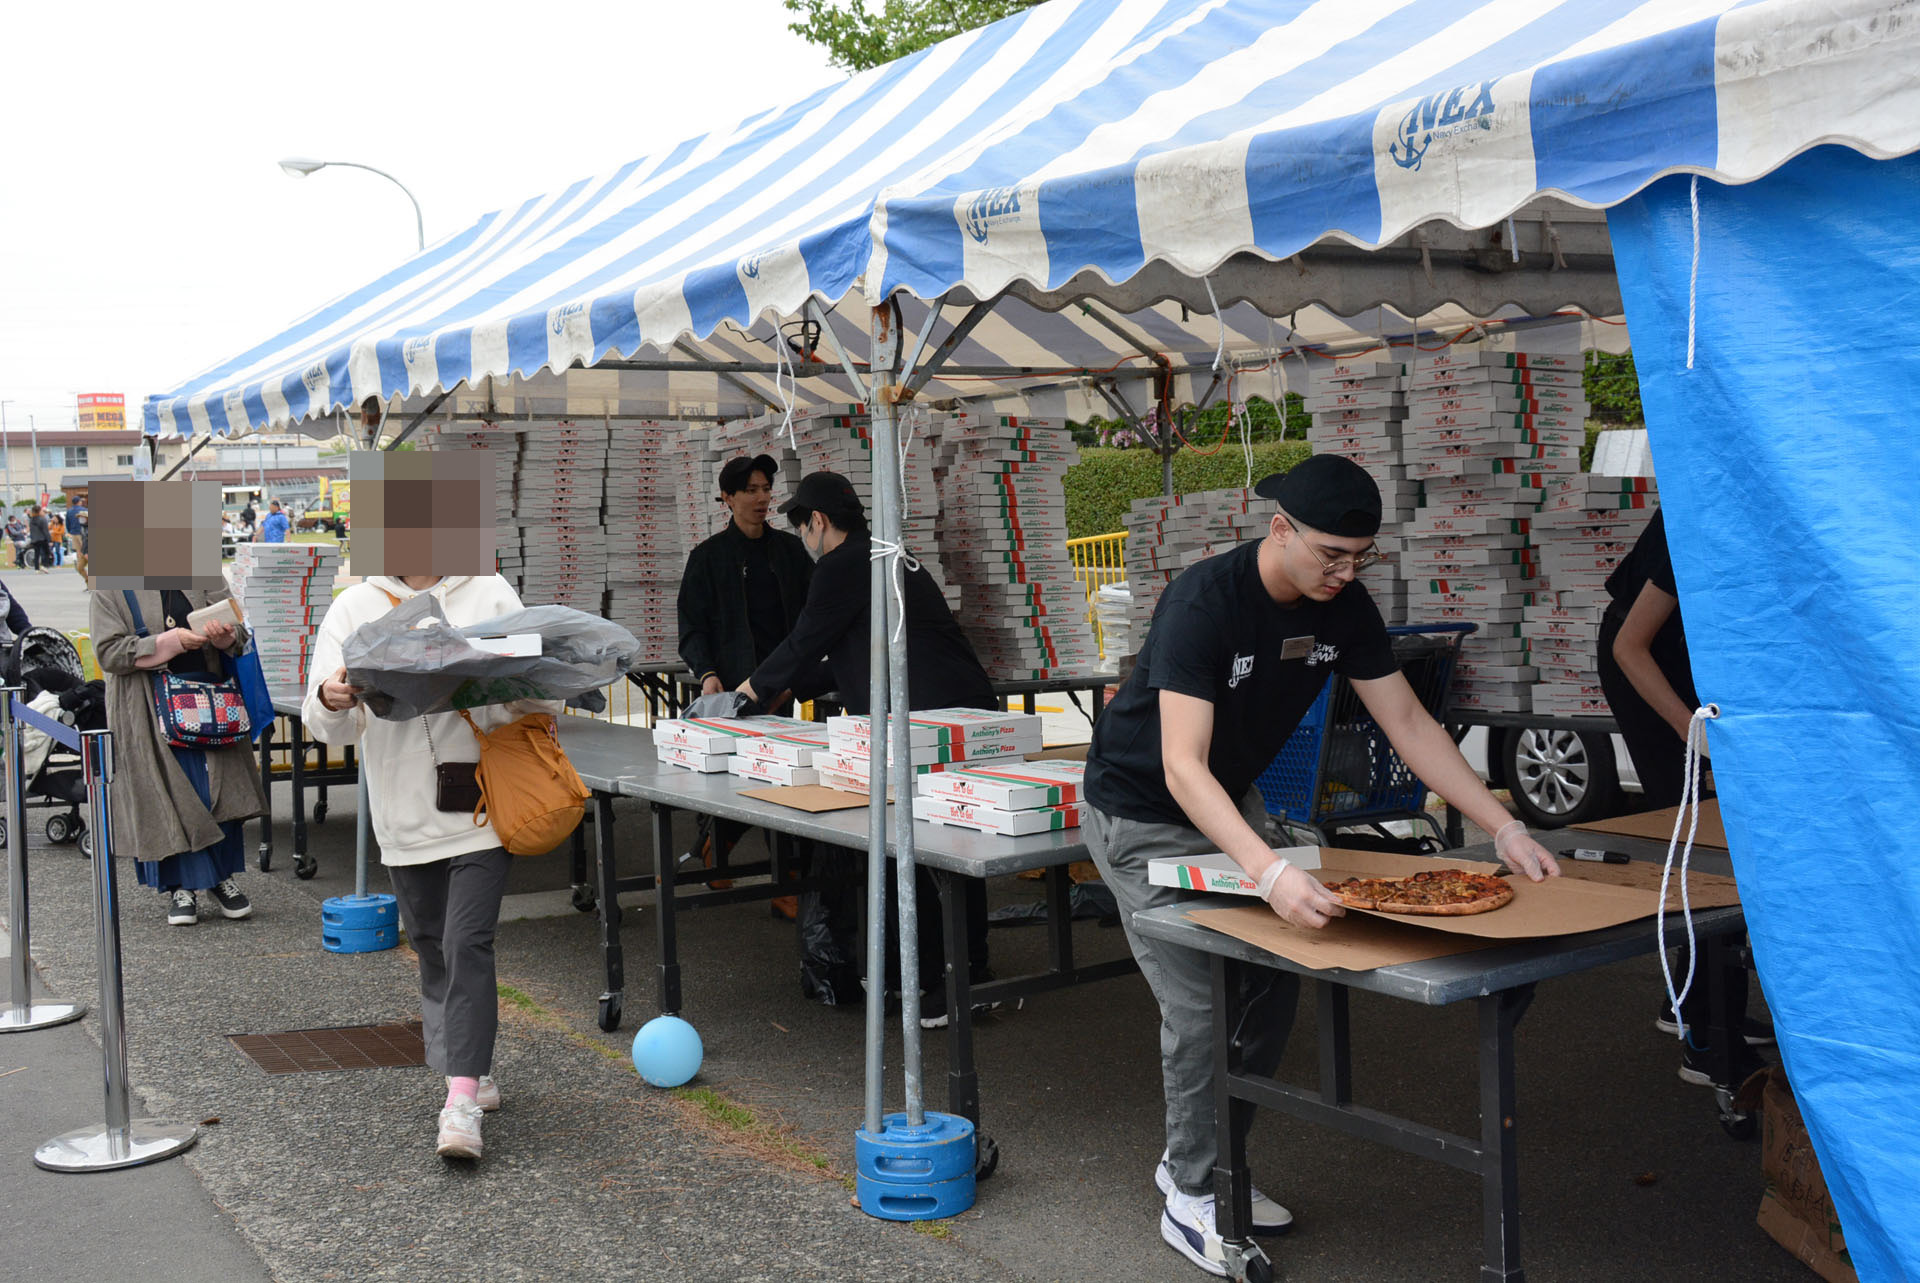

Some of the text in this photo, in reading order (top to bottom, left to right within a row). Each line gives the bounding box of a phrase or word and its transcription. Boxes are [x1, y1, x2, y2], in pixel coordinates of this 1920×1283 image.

[1406, 77, 1500, 135] NEX
[1433, 130, 1453, 140] Navy
[971, 186, 1023, 219] NEX
[1587, 512, 1599, 520] Hot
[1608, 509, 1619, 519] Go!
[1581, 529, 1592, 537] Hot
[1602, 527, 1612, 536] Go!
[1594, 544, 1606, 552] Hot
[1616, 543, 1626, 552] Go!
[1595, 560, 1607, 568] Hot
[971, 726, 1015, 737] Anthony's Pizza
[972, 747, 1000, 756] Anthony's
[952, 782, 961, 792] Hot
[950, 806, 959, 817] Hot
[966, 808, 974, 820] Go!
[1211, 878, 1256, 890] Anthony's Pizza
